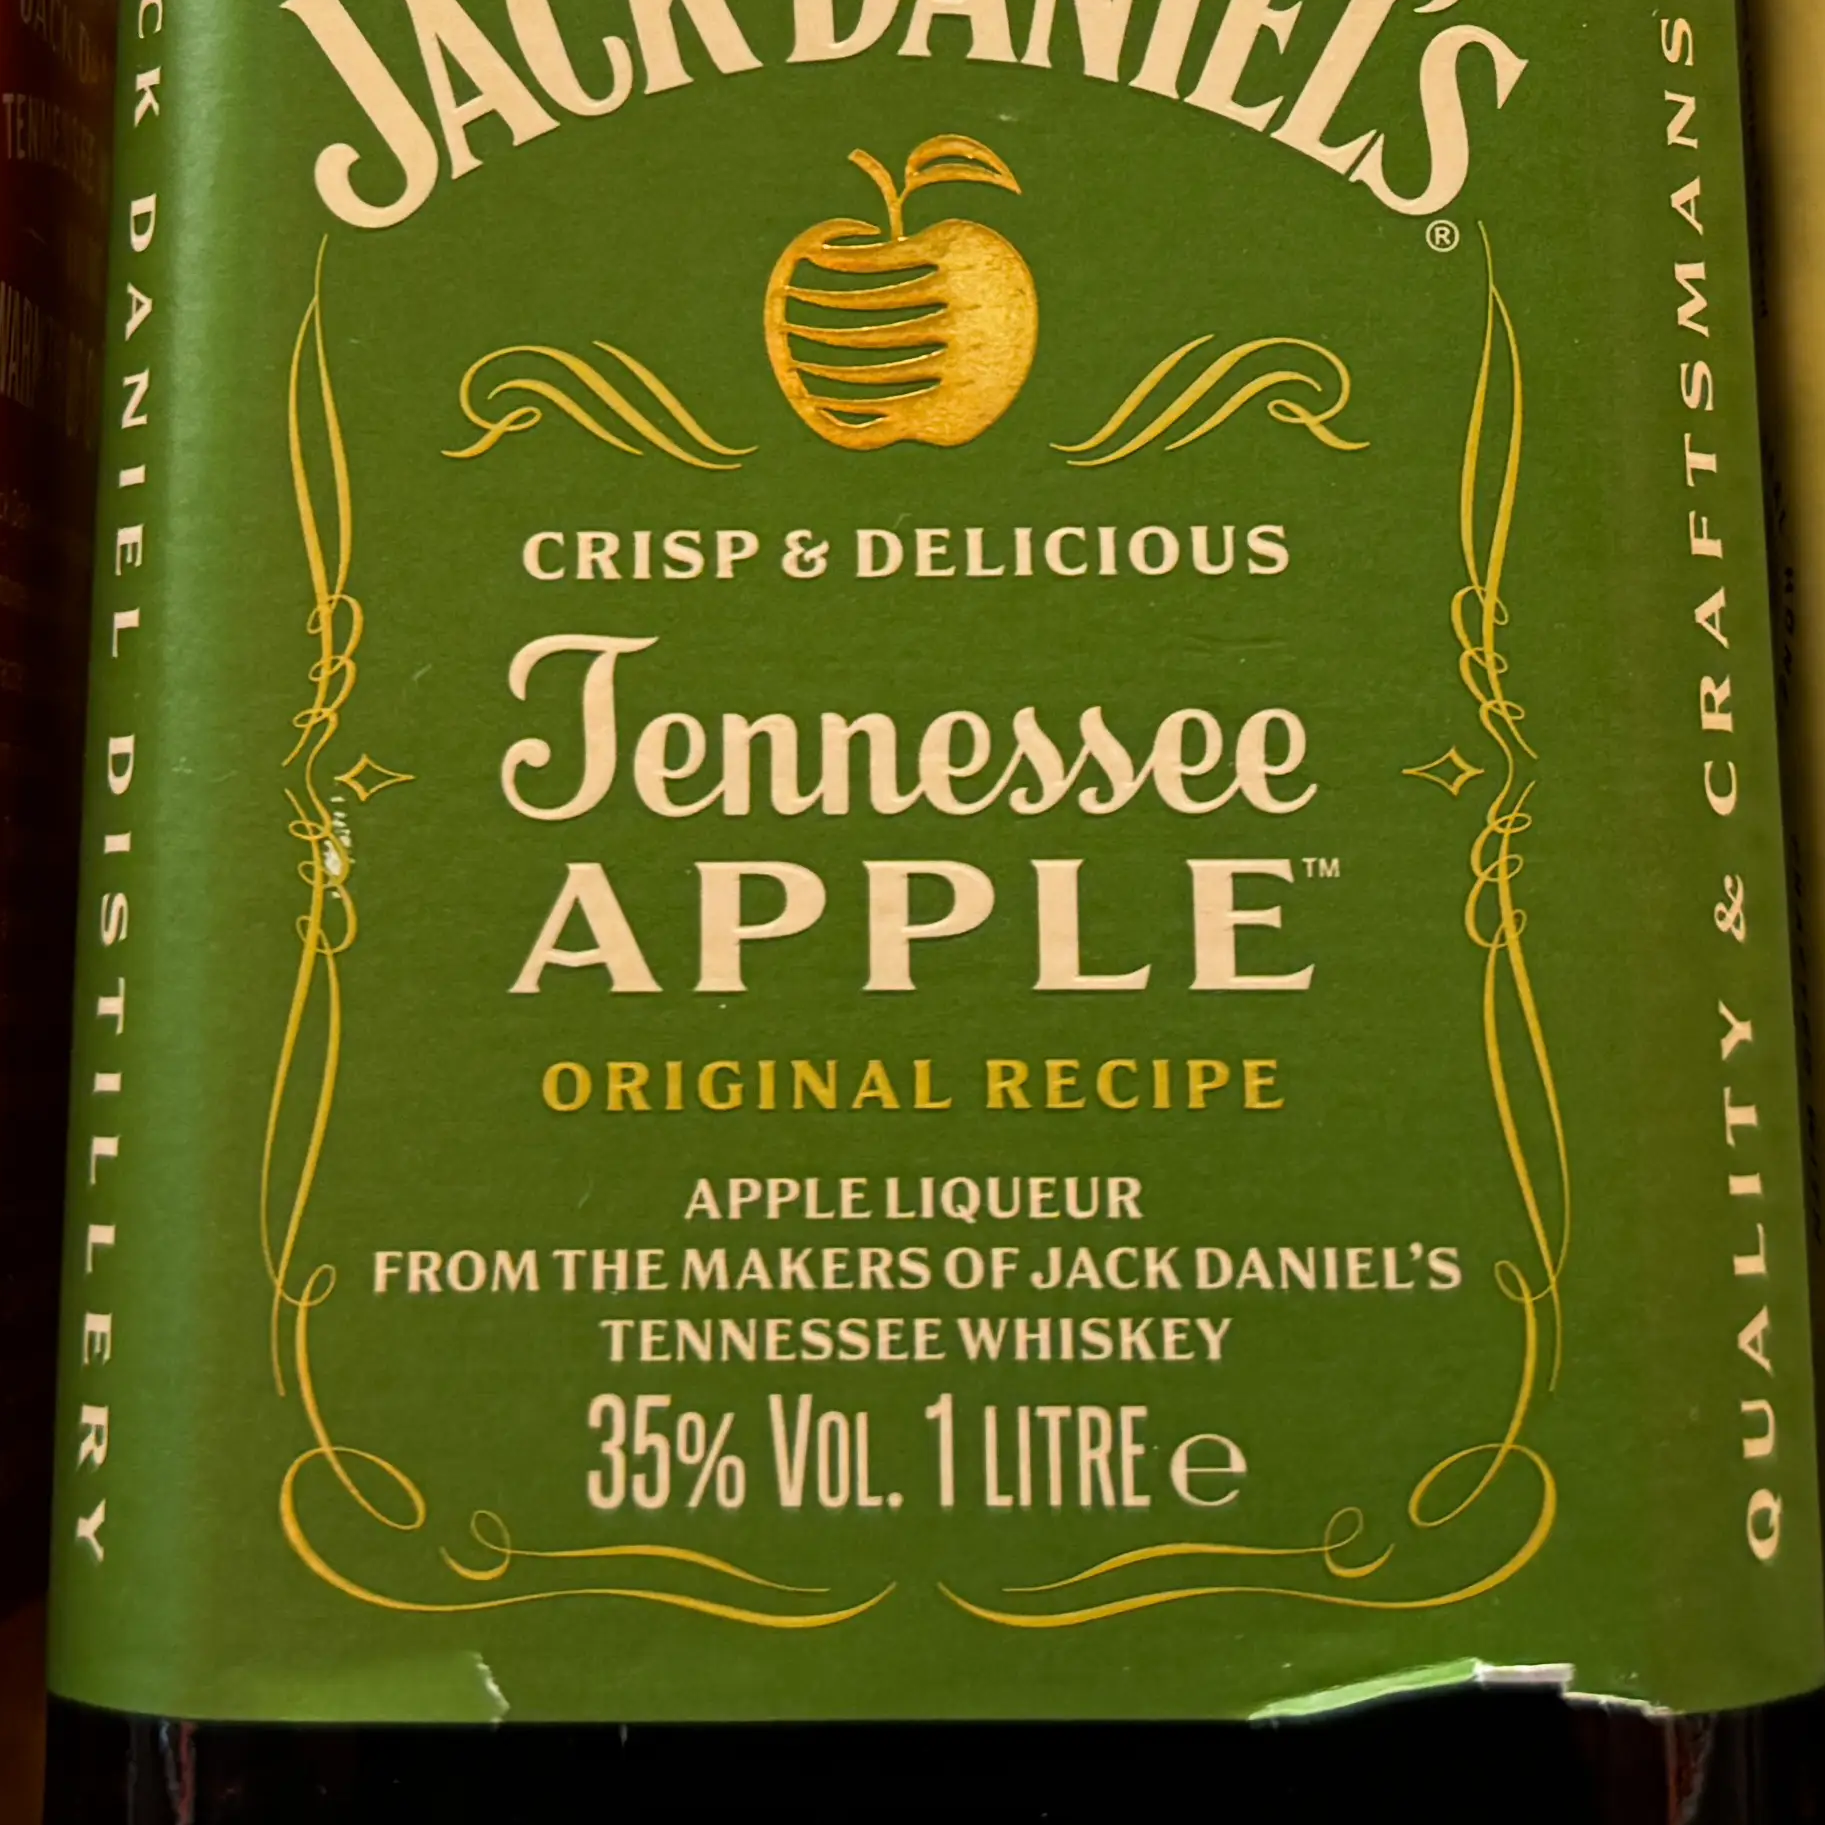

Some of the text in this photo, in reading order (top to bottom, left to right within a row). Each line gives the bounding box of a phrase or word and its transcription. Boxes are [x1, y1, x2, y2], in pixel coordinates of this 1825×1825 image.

[110, 192, 159, 659] DANIEL
[523, 525, 1288, 579] CRISP & DELICIOUS
[501, 634, 1317, 820] Tennessee
[1713, 873, 1749, 942] &
[543, 1059, 1283, 1111] ORIGINAL RECIPE
[76, 733, 136, 1562] DISTILLERY
[685, 1177, 1142, 1223] APPLE LIQUEUR
[374, 1243, 1461, 1292] FROM THE MAKERS OF JACK DANIEL'S
[1719, 998, 1780, 1561] QUALITY
[600, 1318, 1230, 1361] TENNESSEE WHISKEY
[588, 1394, 745, 1509] 35%
[926, 1394, 954, 1507] 1
[985, 1406, 1150, 1507] LITRE
